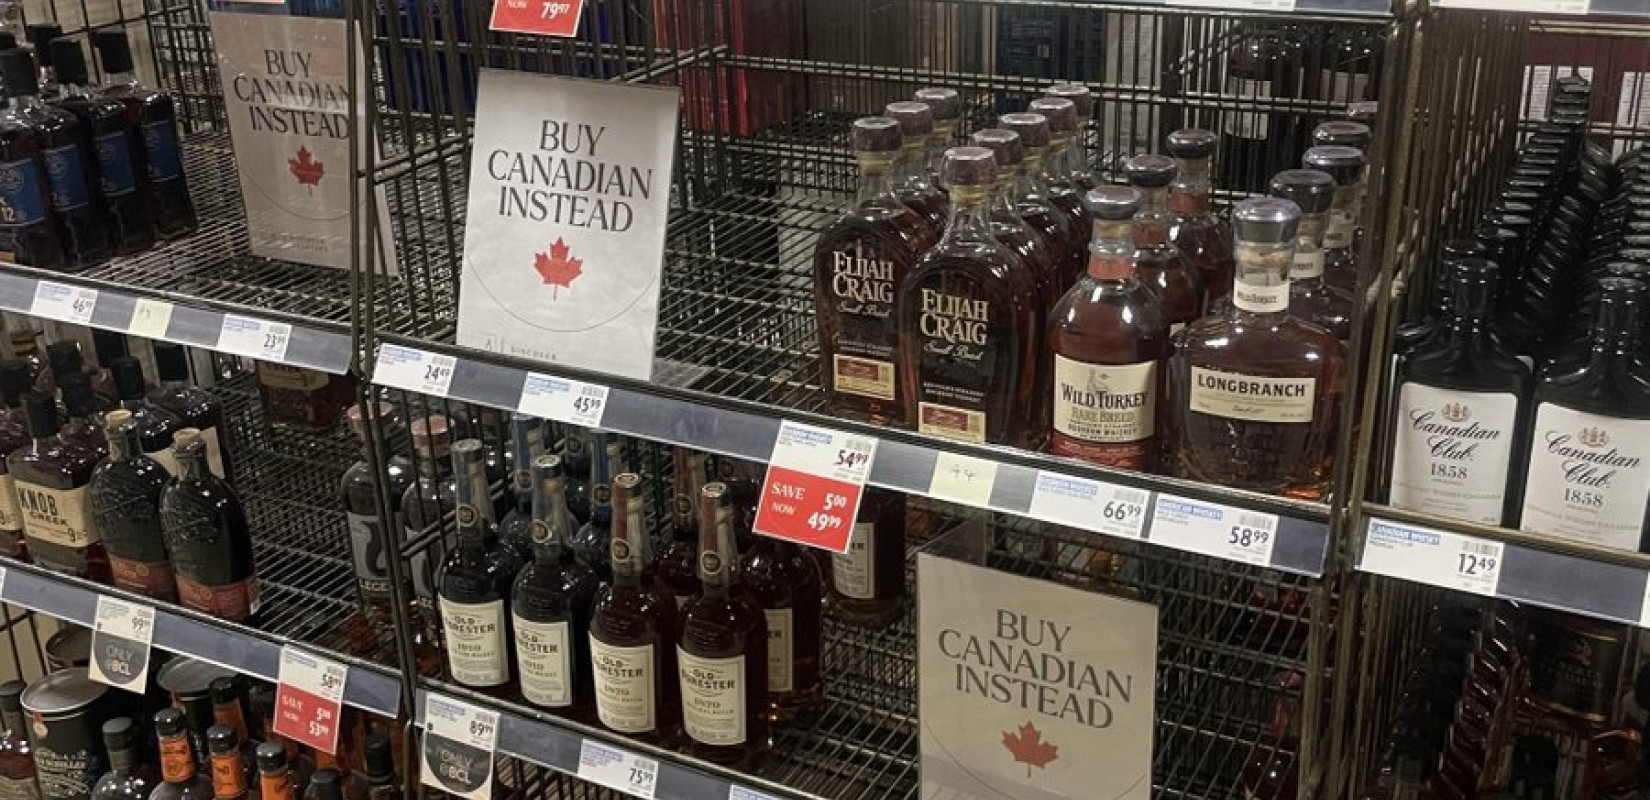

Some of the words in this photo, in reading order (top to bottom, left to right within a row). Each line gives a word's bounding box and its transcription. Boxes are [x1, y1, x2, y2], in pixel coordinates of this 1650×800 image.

[264, 49, 311, 79] BUY
[249, 105, 350, 139] INSTEAD
[539, 118, 606, 157] BUY
[488, 150, 653, 199] CANADIAN
[498, 186, 634, 232] INSTEAD
[832, 251, 894, 282] ELIJAH
[833, 273, 894, 304] CRAIG
[921, 288, 989, 322] ELIJAH
[919, 312, 987, 345] CRAIG
[1061, 382, 1095, 408] WILD
[1096, 390, 1148, 410] TURKEY
[1197, 373, 1306, 397] LONGBRANCH
[1409, 408, 1501, 441] Canadian
[1427, 436, 1475, 462] Club
[1546, 430, 1641, 468] Canadian
[1430, 463, 1468, 479] 1858
[1561, 459, 1611, 488] Club
[18, 487, 58, 516] KNOB
[771, 481, 806, 501] SAVE
[1563, 487, 1604, 507] 1858
[771, 502, 796, 515] NOW
[1103, 500, 1141, 520] 6699
[1228, 525, 1270, 547] 5899
[1458, 554, 1497, 575] 1249
[996, 608, 1072, 652] BUY
[938, 628, 1132, 703] CANADIAN
[955, 663, 1114, 729] INSTEAD
